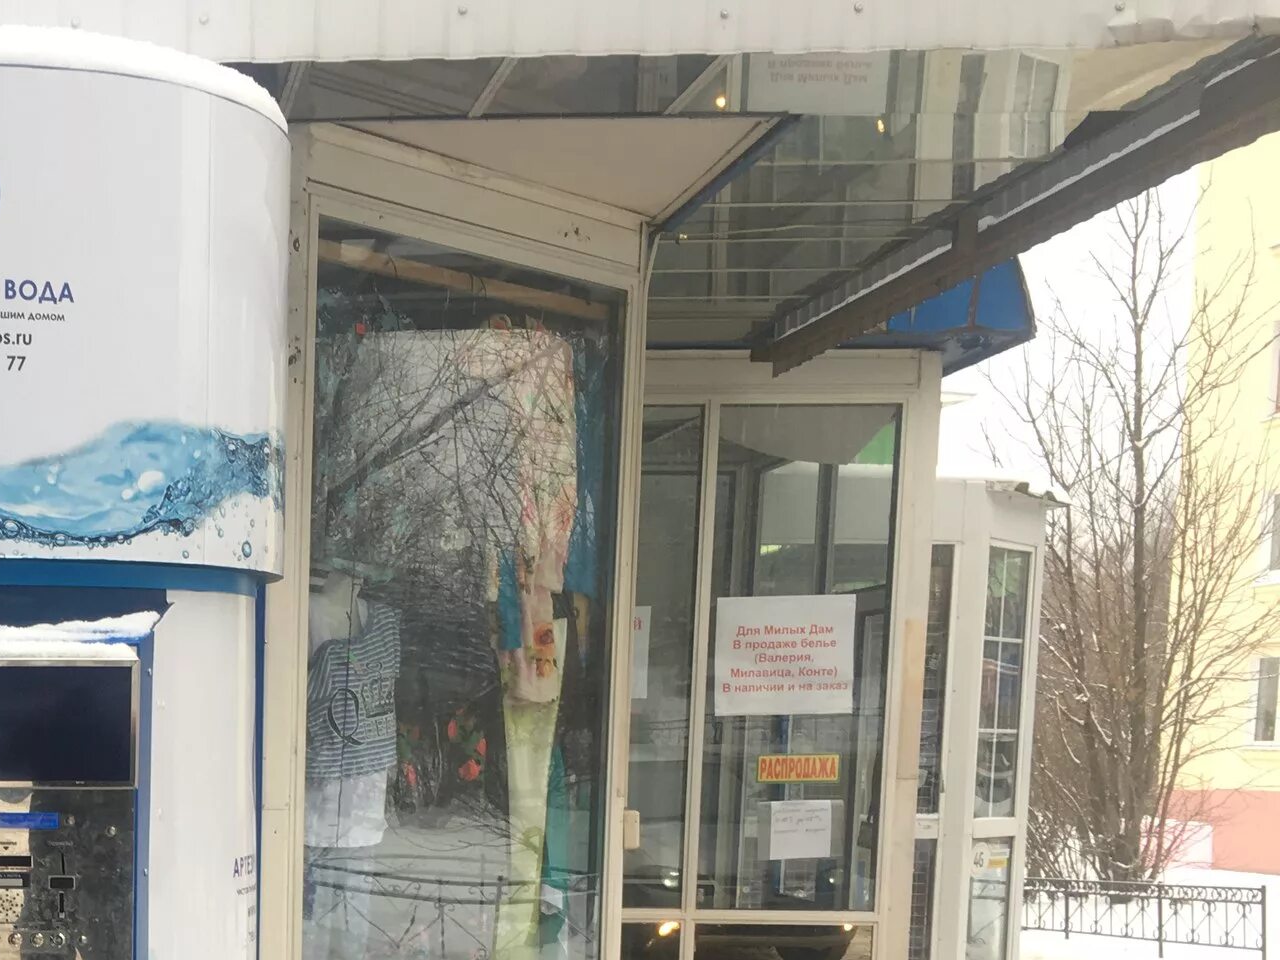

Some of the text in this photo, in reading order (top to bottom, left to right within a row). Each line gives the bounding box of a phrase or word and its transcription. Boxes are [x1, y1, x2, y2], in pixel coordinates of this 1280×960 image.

[4, 279, 75, 304] ВОДА
[28, 313, 65, 321] домом
[6, 356, 26, 371] 77
[736, 624, 833, 637] Для Милых Дам
[732, 638, 837, 651] В продаже белье
[798, 666, 838, 678] Конте)
[722, 681, 848, 693] В наличии и на заказ
[759, 757, 837, 780] РАСПРОДАЖА
